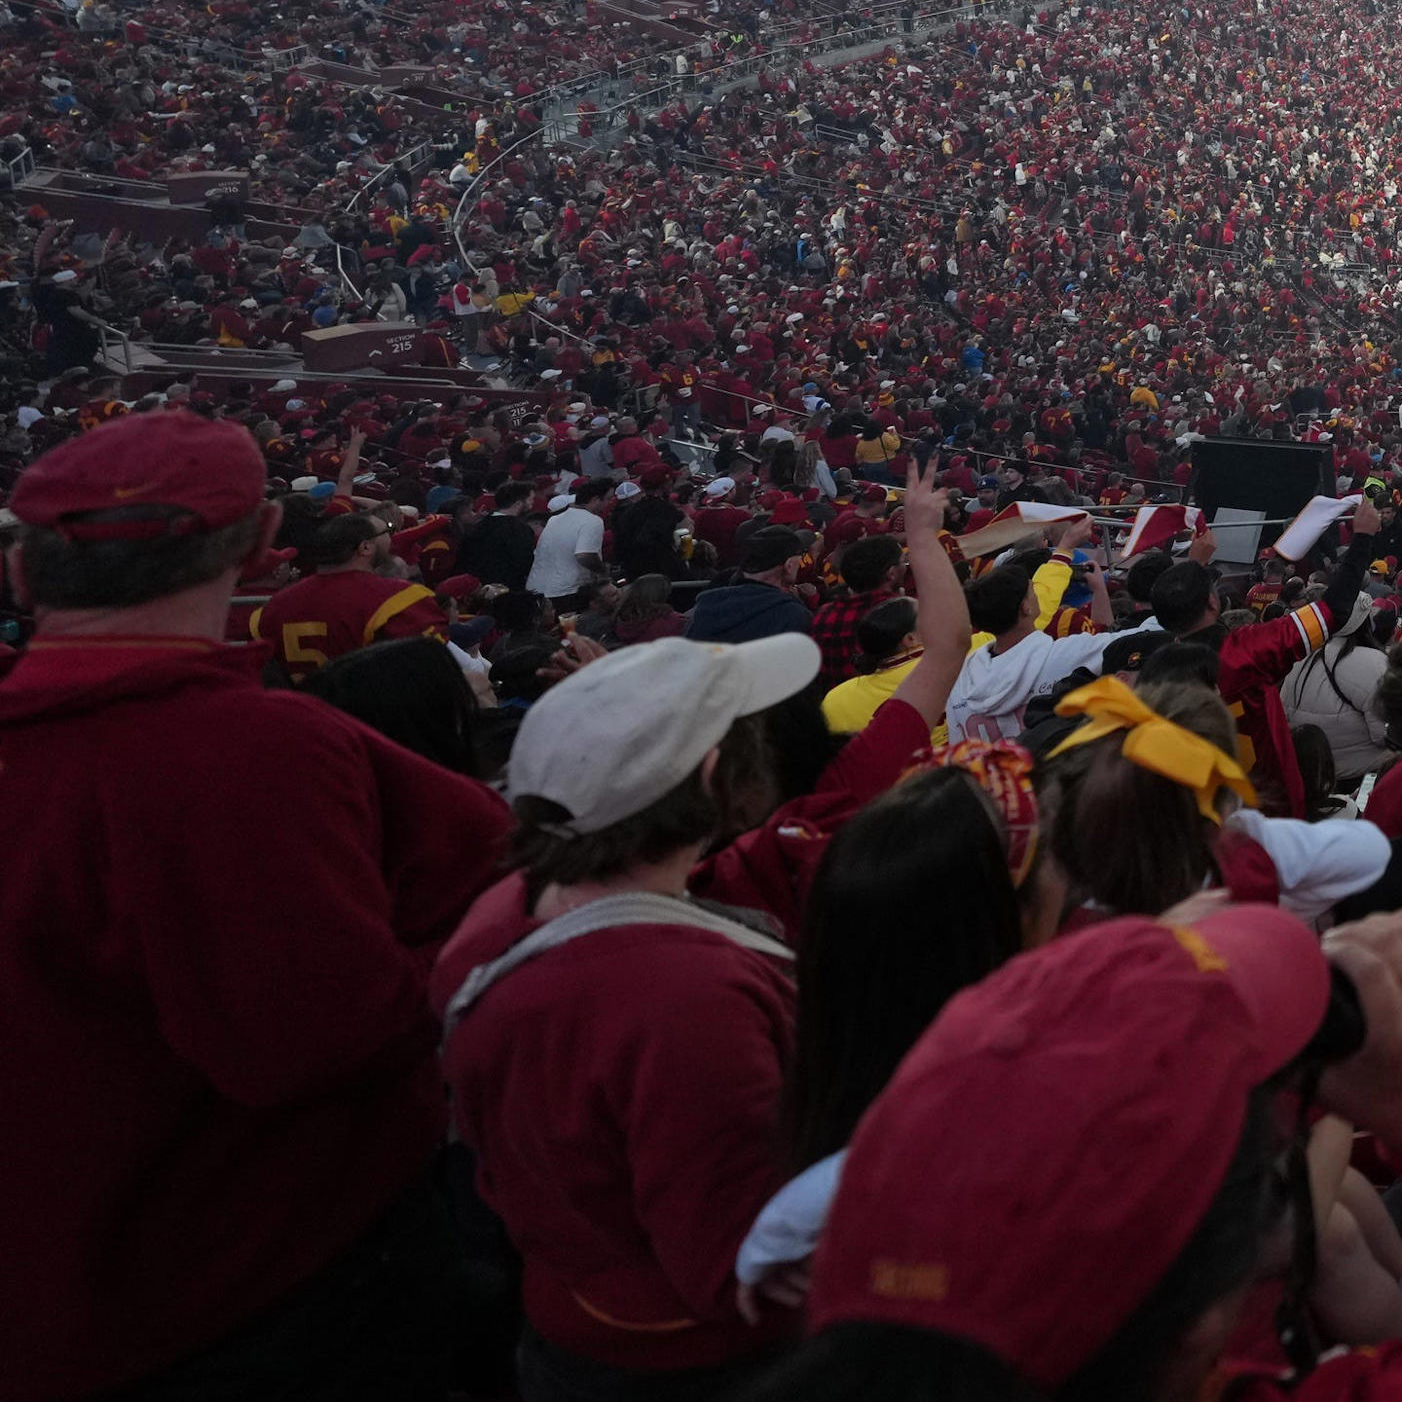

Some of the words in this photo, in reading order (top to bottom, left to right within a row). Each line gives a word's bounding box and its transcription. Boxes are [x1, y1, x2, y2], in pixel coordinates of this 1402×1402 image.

[386, 334, 416, 344] SECTION
[392, 340, 412, 353] 215
[682, 374, 693, 386] 6
[511, 406, 526, 417] 215
[1048, 416, 1056, 429] 7
[282, 621, 329, 668] 5
